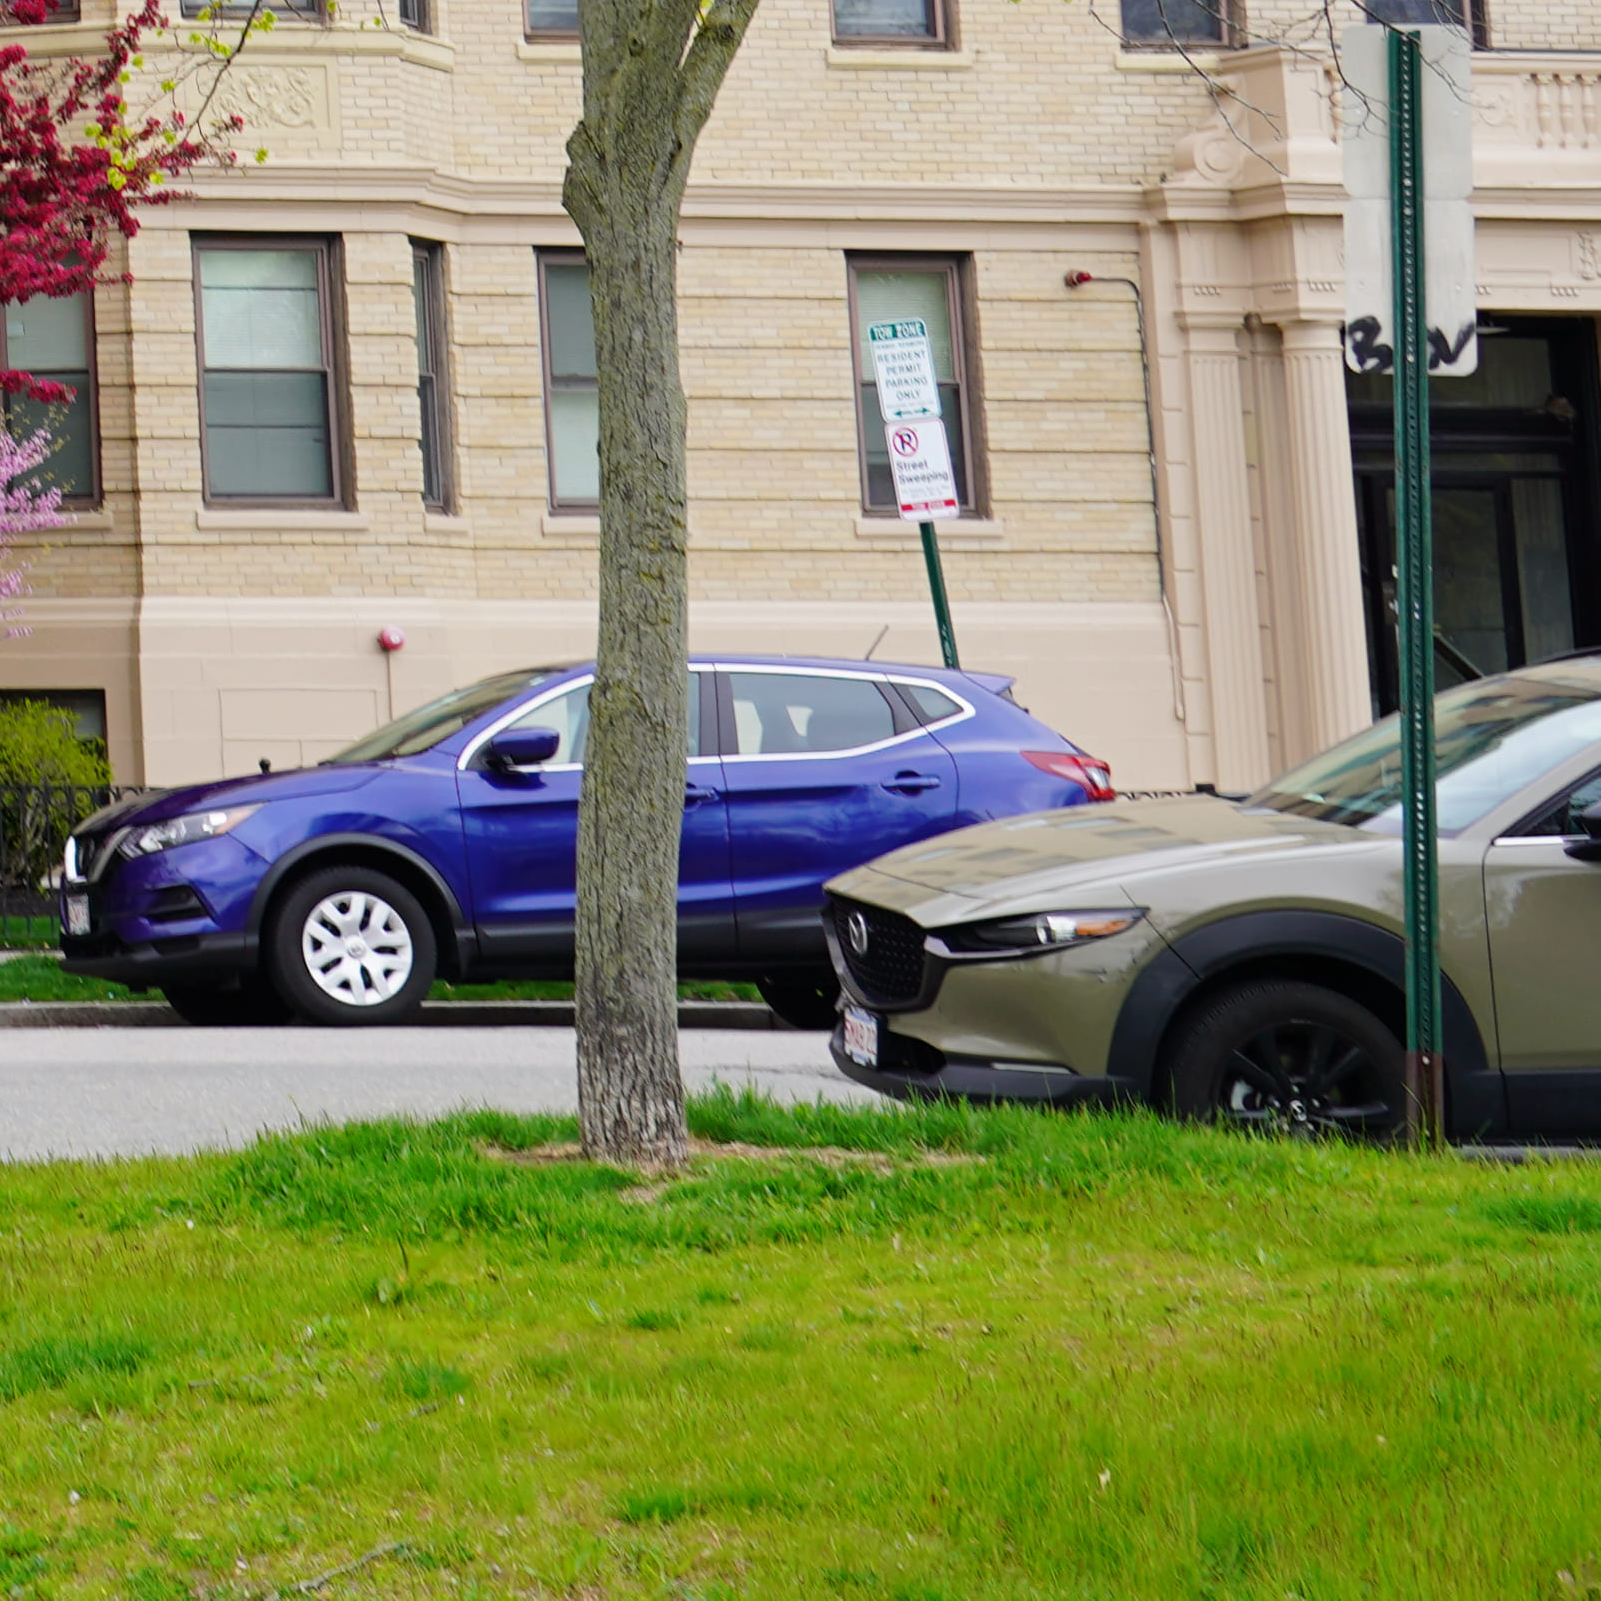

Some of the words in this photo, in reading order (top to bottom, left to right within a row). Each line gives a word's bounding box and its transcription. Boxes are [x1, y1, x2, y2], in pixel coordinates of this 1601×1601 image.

[896, 322, 923, 338] ZONE
[877, 351, 926, 363] RESIDENT
[886, 363, 921, 375] PERMIT
[885, 376, 928, 388] PARKING
[896, 390, 920, 402] ONLY
[896, 459, 928, 471] Street
[898, 471, 949, 485] Sweeping
